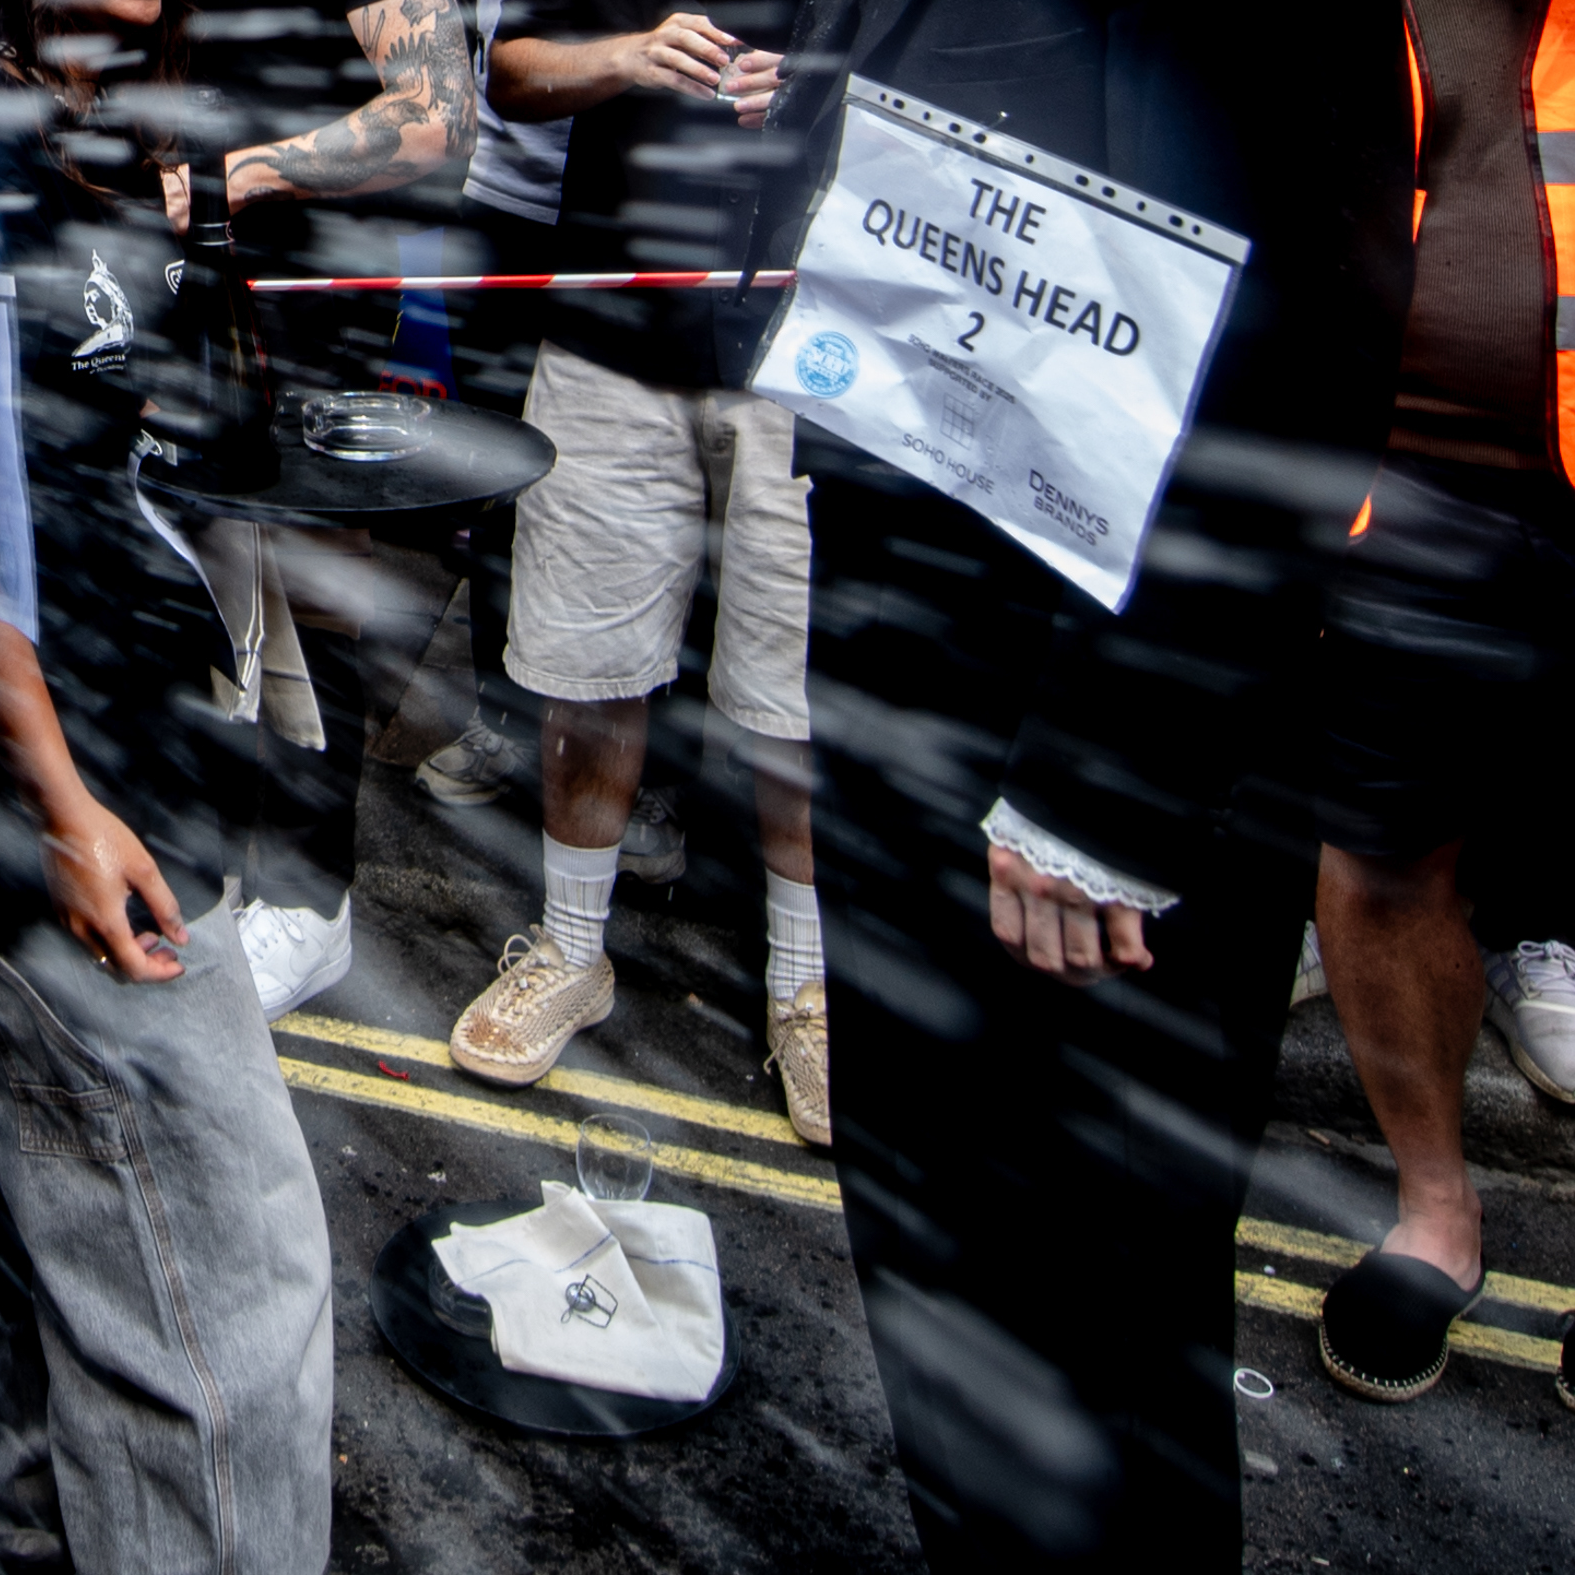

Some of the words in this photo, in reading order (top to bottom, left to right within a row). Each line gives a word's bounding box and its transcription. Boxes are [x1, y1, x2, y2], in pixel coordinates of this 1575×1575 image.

[970, 177, 1047, 245] THE
[862, 199, 1006, 296] QUEENS
[1012, 269, 1141, 357] HEAD
[956, 311, 986, 353] 2
[901, 433, 944, 464] SOHO
[947, 453, 995, 496] HOUSE
[1033, 495, 1098, 547] BRANDS
